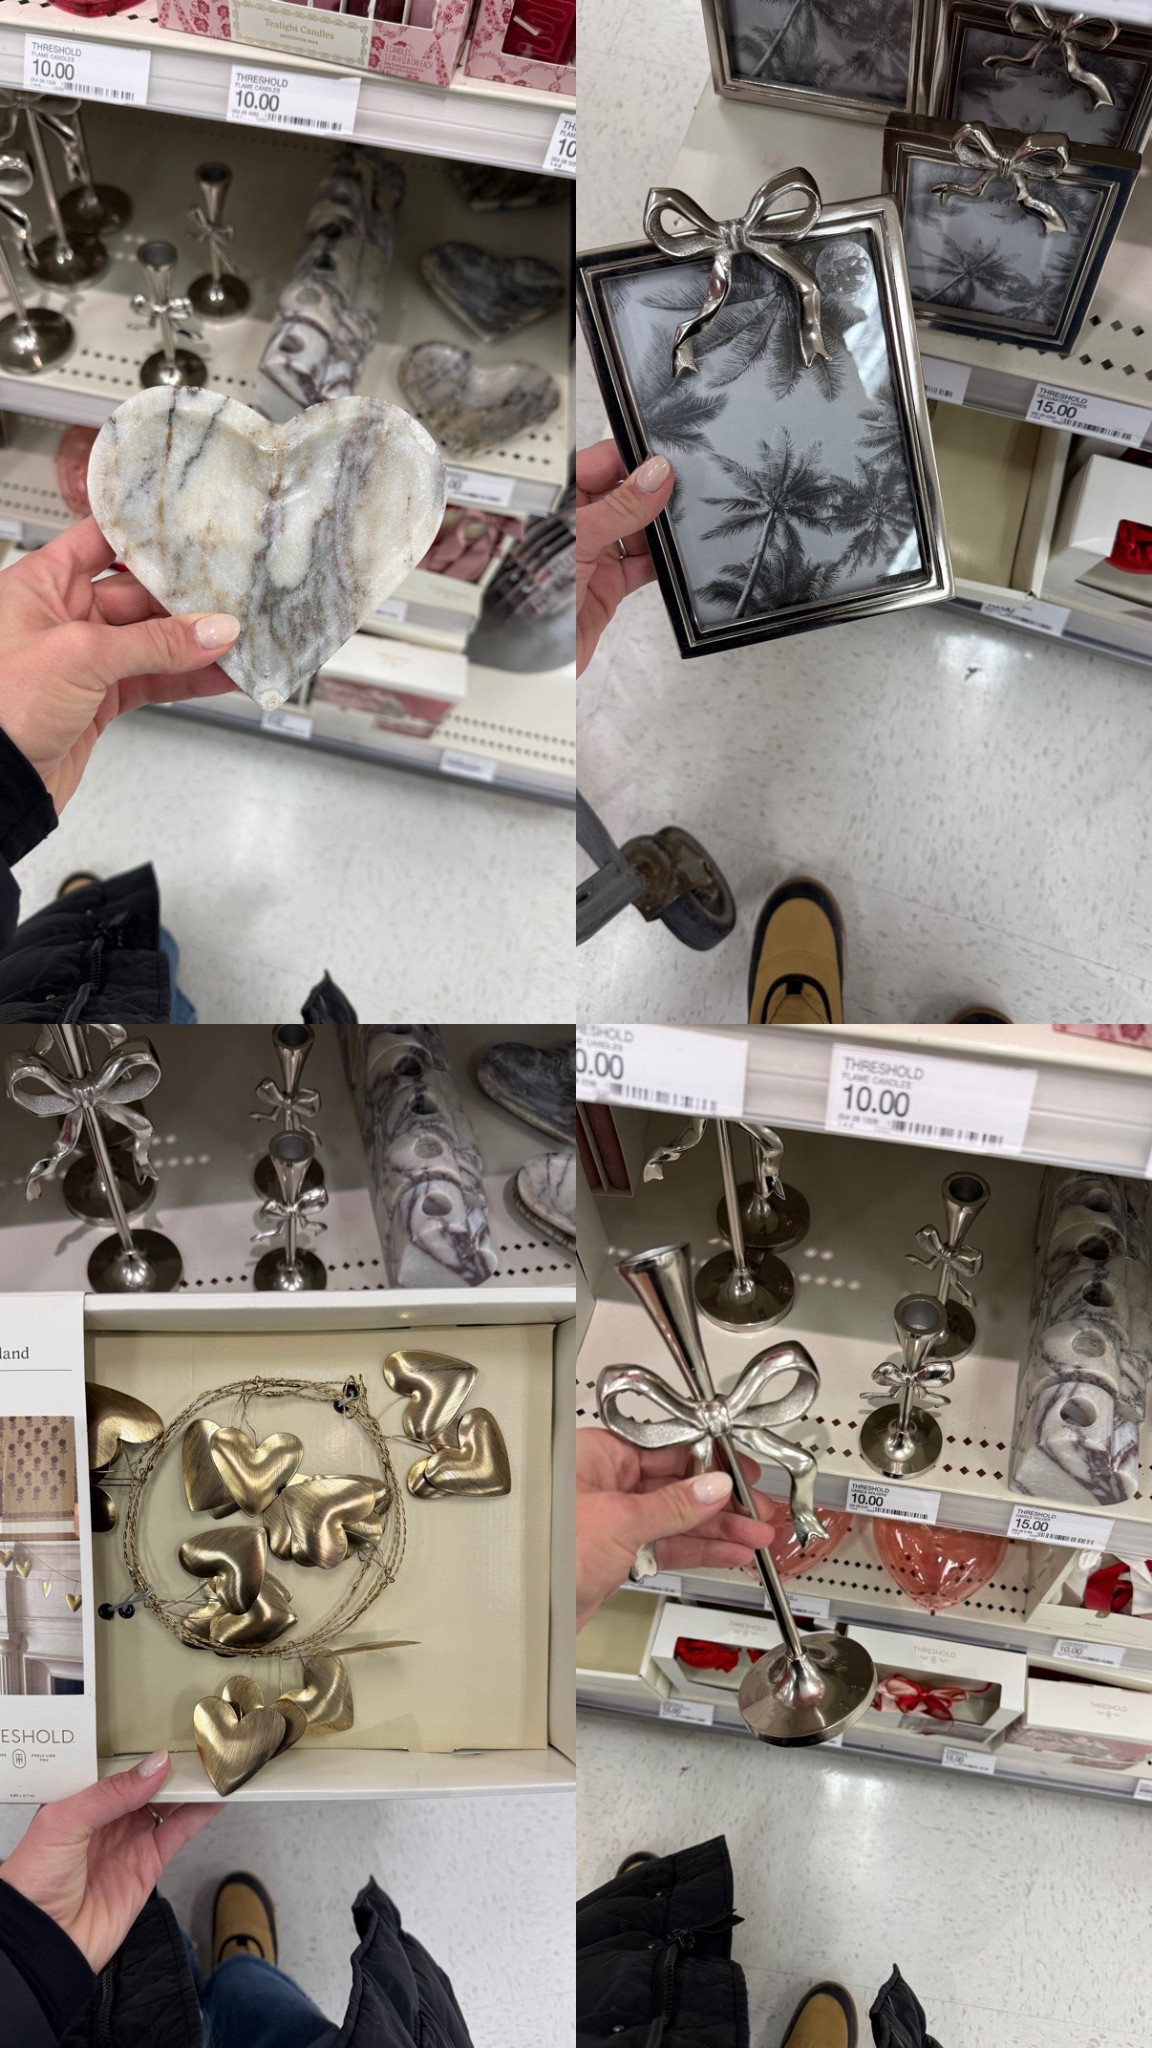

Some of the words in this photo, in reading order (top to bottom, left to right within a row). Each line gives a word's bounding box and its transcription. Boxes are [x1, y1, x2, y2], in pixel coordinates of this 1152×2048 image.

[264, 18, 298, 33] Tealight
[300, 26, 334, 40] Candles
[32, 42, 82, 57] THRESHOLD
[32, 51, 49, 59] FLAME
[50, 53, 75, 63] CANDLES
[32, 58, 74, 80] 10.00
[420, 60, 434, 69] EACH
[235, 82, 254, 90] FLAME
[254, 85, 280, 94] CANDLES
[236, 73, 288, 88] THRESHOLD
[236, 90, 280, 112] 10.00
[1037, 393, 1069, 404] DECORATIVE
[1039, 387, 1088, 404] THRESHOLD
[1036, 400, 1077, 418] 15.00
[843, 1057, 924, 1080] THRESHOLD
[842, 1072, 870, 1084] FLAME
[872, 1075, 912, 1090] CANDLES
[843, 1084, 910, 1118] 10.00
[852, 1483, 889, 1494] THRESHOLD
[852, 1493, 883, 1506] 10.00
[1017, 1508, 1056, 1519] THRESHOLD
[1016, 1518, 1049, 1532] 15.00
